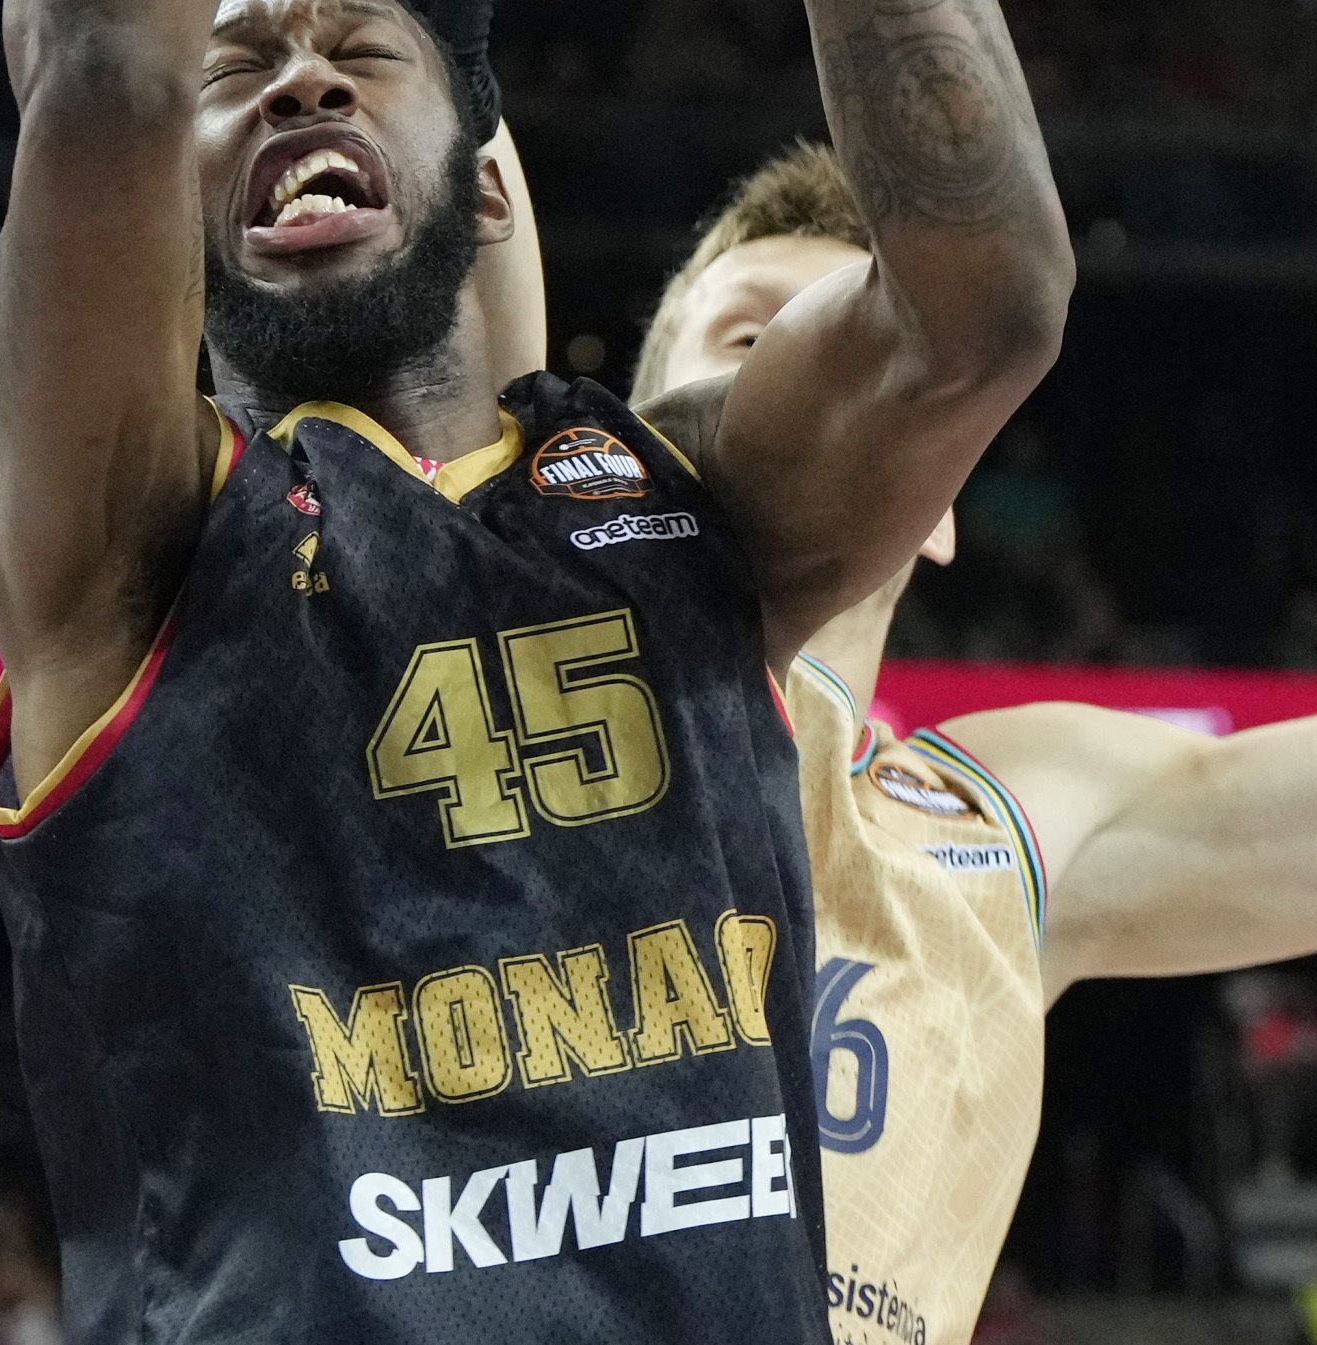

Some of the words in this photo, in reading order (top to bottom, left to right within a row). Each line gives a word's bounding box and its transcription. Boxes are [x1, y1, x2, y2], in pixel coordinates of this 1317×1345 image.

[539, 453, 603, 485] FINAL
[593, 452, 645, 479] FOUR
[572, 513, 697, 547] oneteam
[365, 608, 671, 849] 45
[810, 957, 889, 1153] 6
[338, 1113, 797, 1280] SKWEE
